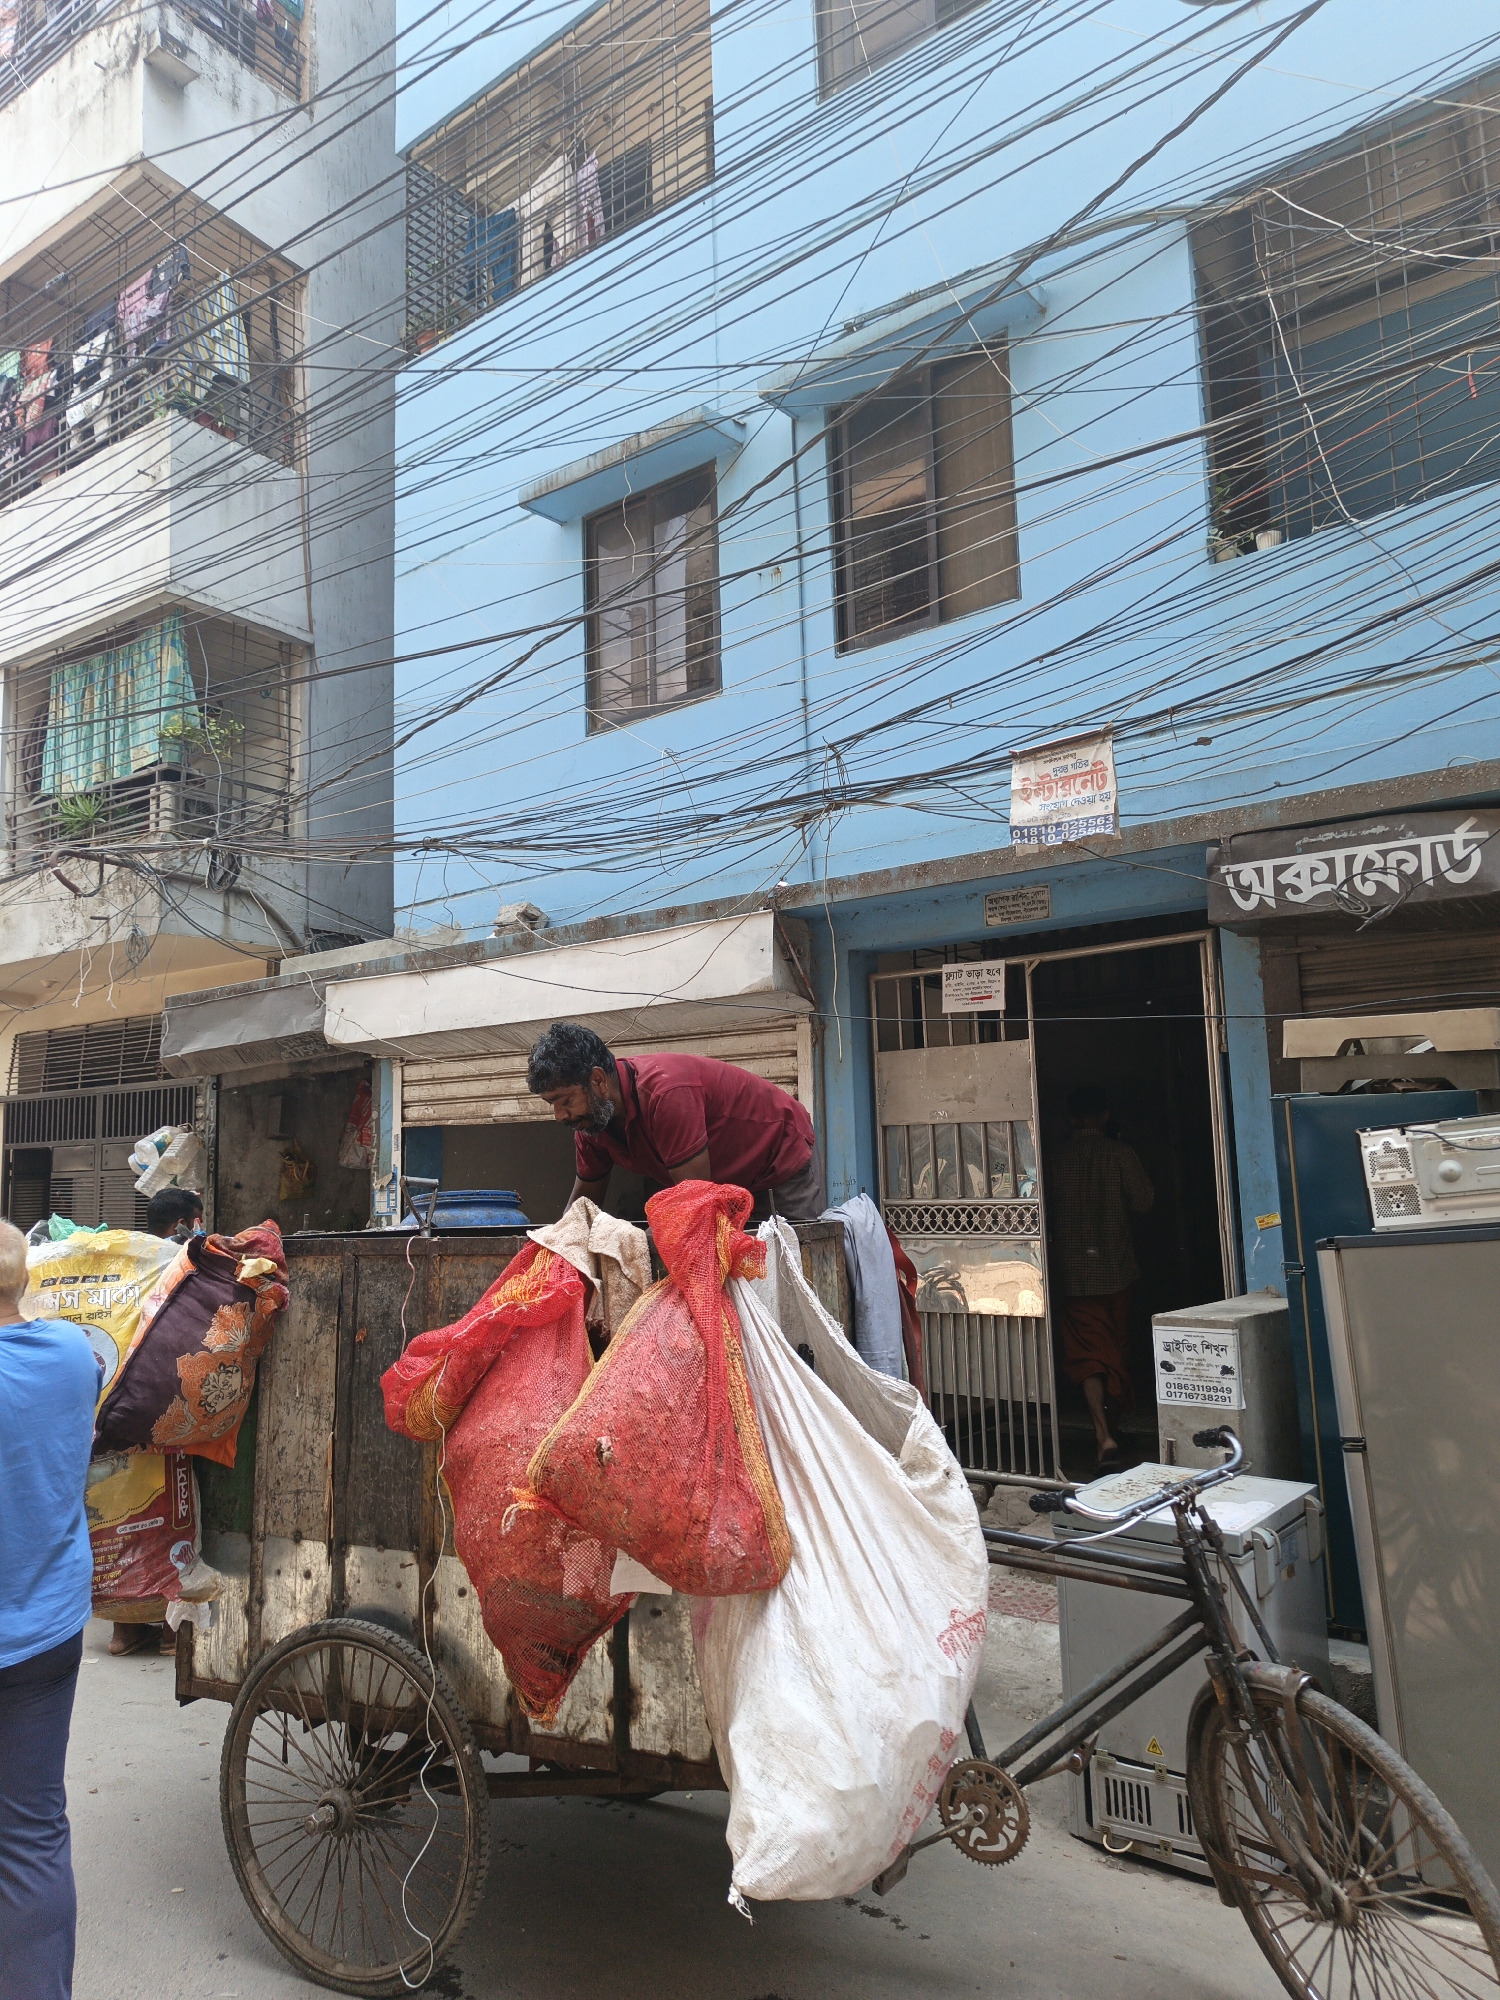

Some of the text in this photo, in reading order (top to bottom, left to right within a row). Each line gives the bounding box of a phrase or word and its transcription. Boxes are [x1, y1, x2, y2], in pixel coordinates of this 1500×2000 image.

[1070, 758, 1089, 771] গতির
[1018, 760, 1109, 805] ইন্টারনেট
[1012, 815, 1114, 839] 01810-025563
[965, 968, 983, 981] ভাড়া
[986, 967, 1001, 977] হবে
[84, 1279, 142, 1309] মার্কা
[85, 1309, 112, 1320] রাইস
[1162, 1338, 1229, 1357] ড্রাইভিং শিখুন
[1165, 1381, 1232, 1395] 01863119949
[1166, 1390, 1232, 1403] 01716738291
[177, 1467, 188, 1519] কলস
